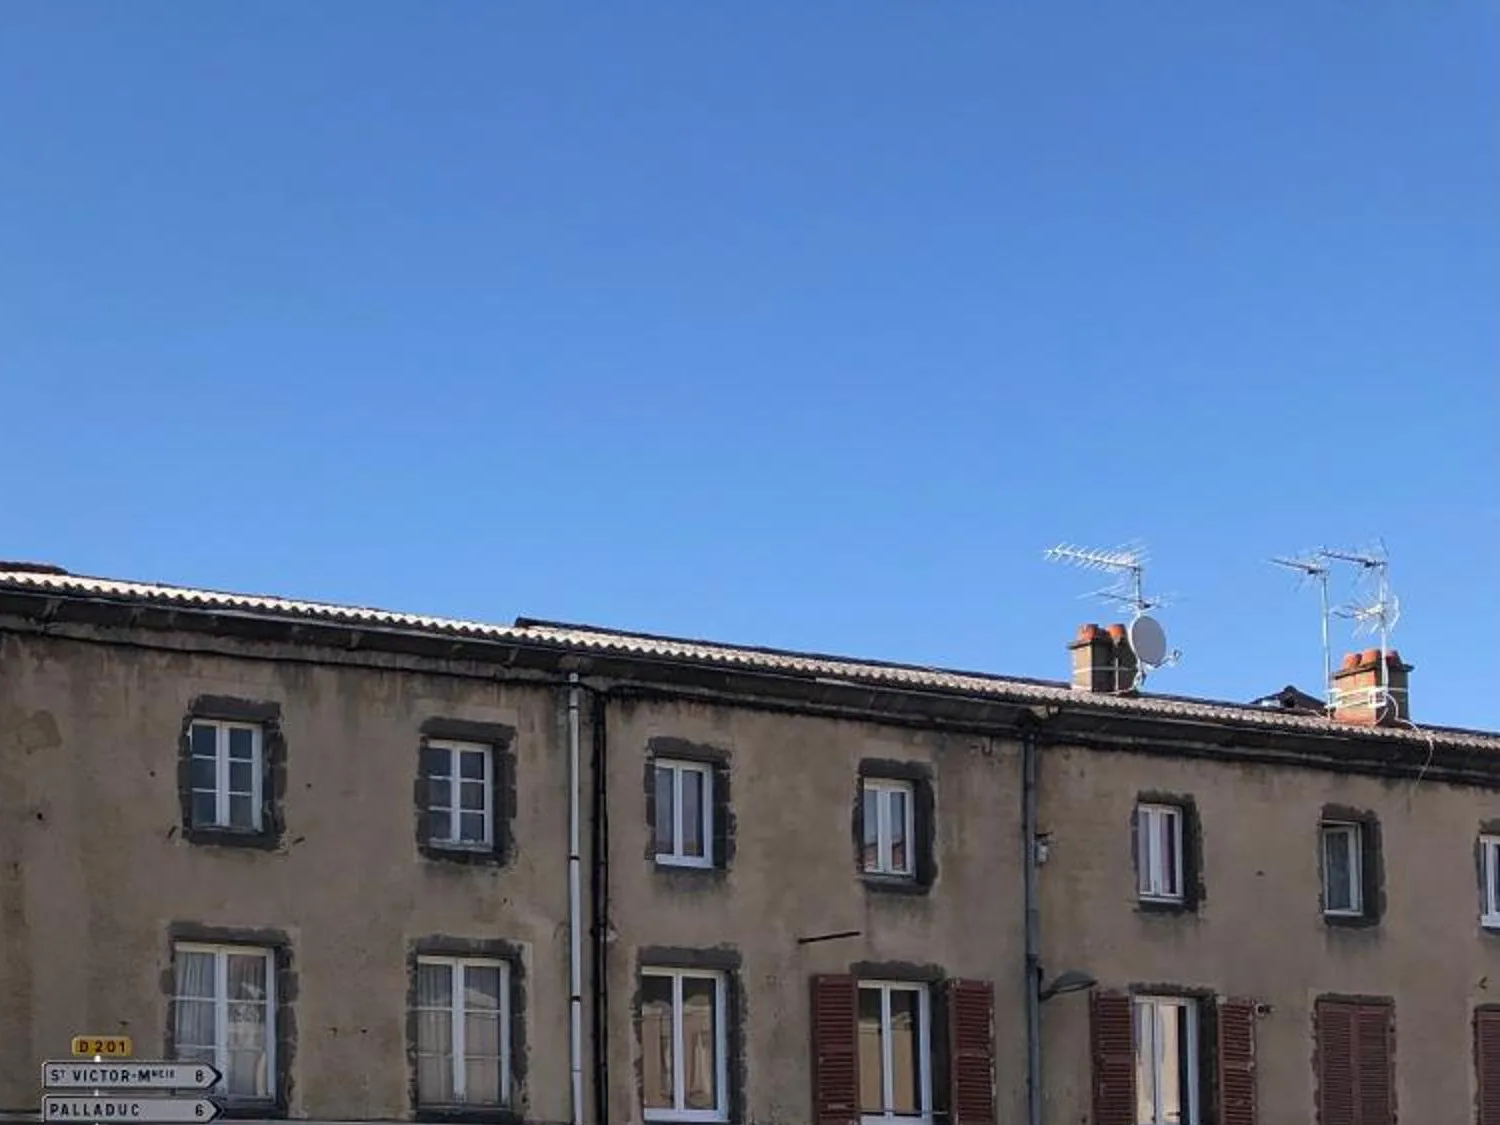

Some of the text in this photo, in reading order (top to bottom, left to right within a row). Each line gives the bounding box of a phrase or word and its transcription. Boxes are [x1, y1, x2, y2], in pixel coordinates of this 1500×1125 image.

[79, 1039, 125, 1052] D 201
[195, 1069, 204, 1083] 8
[50, 1103, 204, 1117] PALLADUC 6
